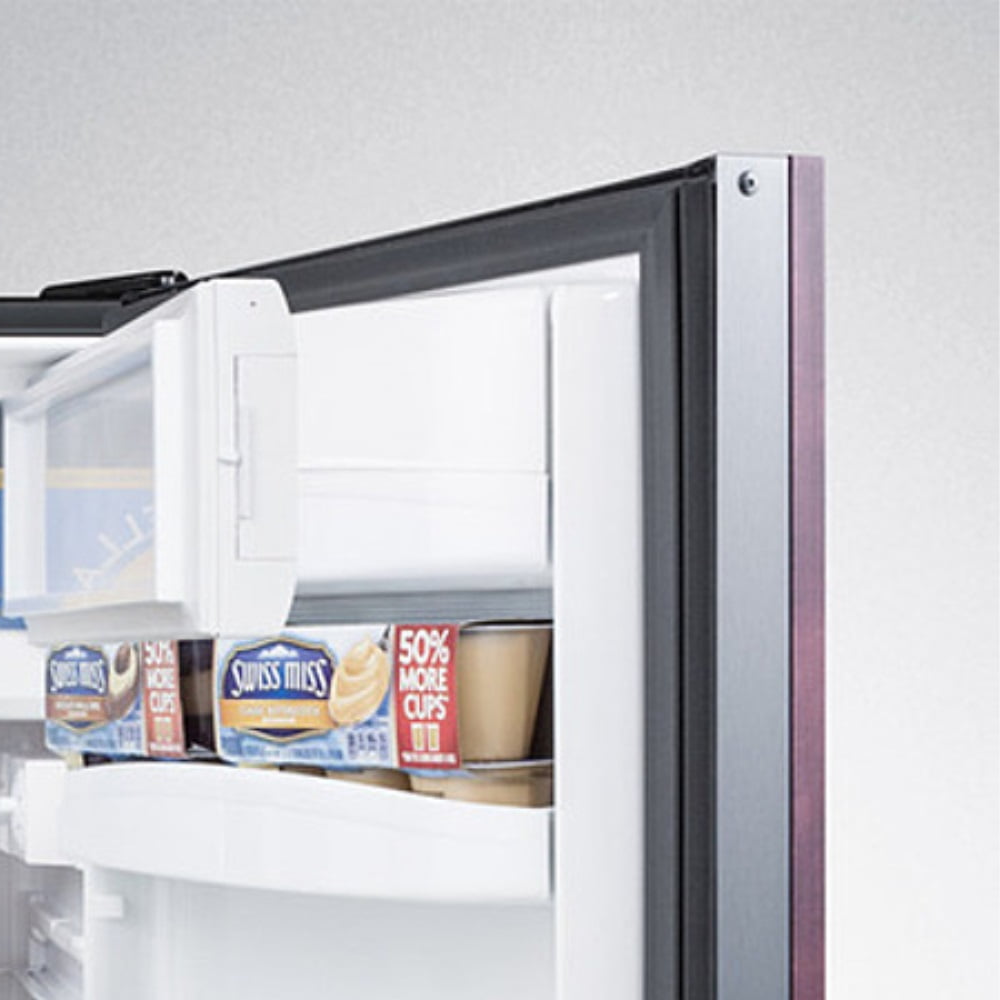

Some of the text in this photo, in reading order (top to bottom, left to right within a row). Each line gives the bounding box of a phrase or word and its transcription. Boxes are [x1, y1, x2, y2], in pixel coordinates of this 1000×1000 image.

[399, 628, 450, 665] 50%
[230, 658, 281, 698] SWISS
[399, 666, 449, 692] MORE
[402, 693, 448, 720] CUPS
